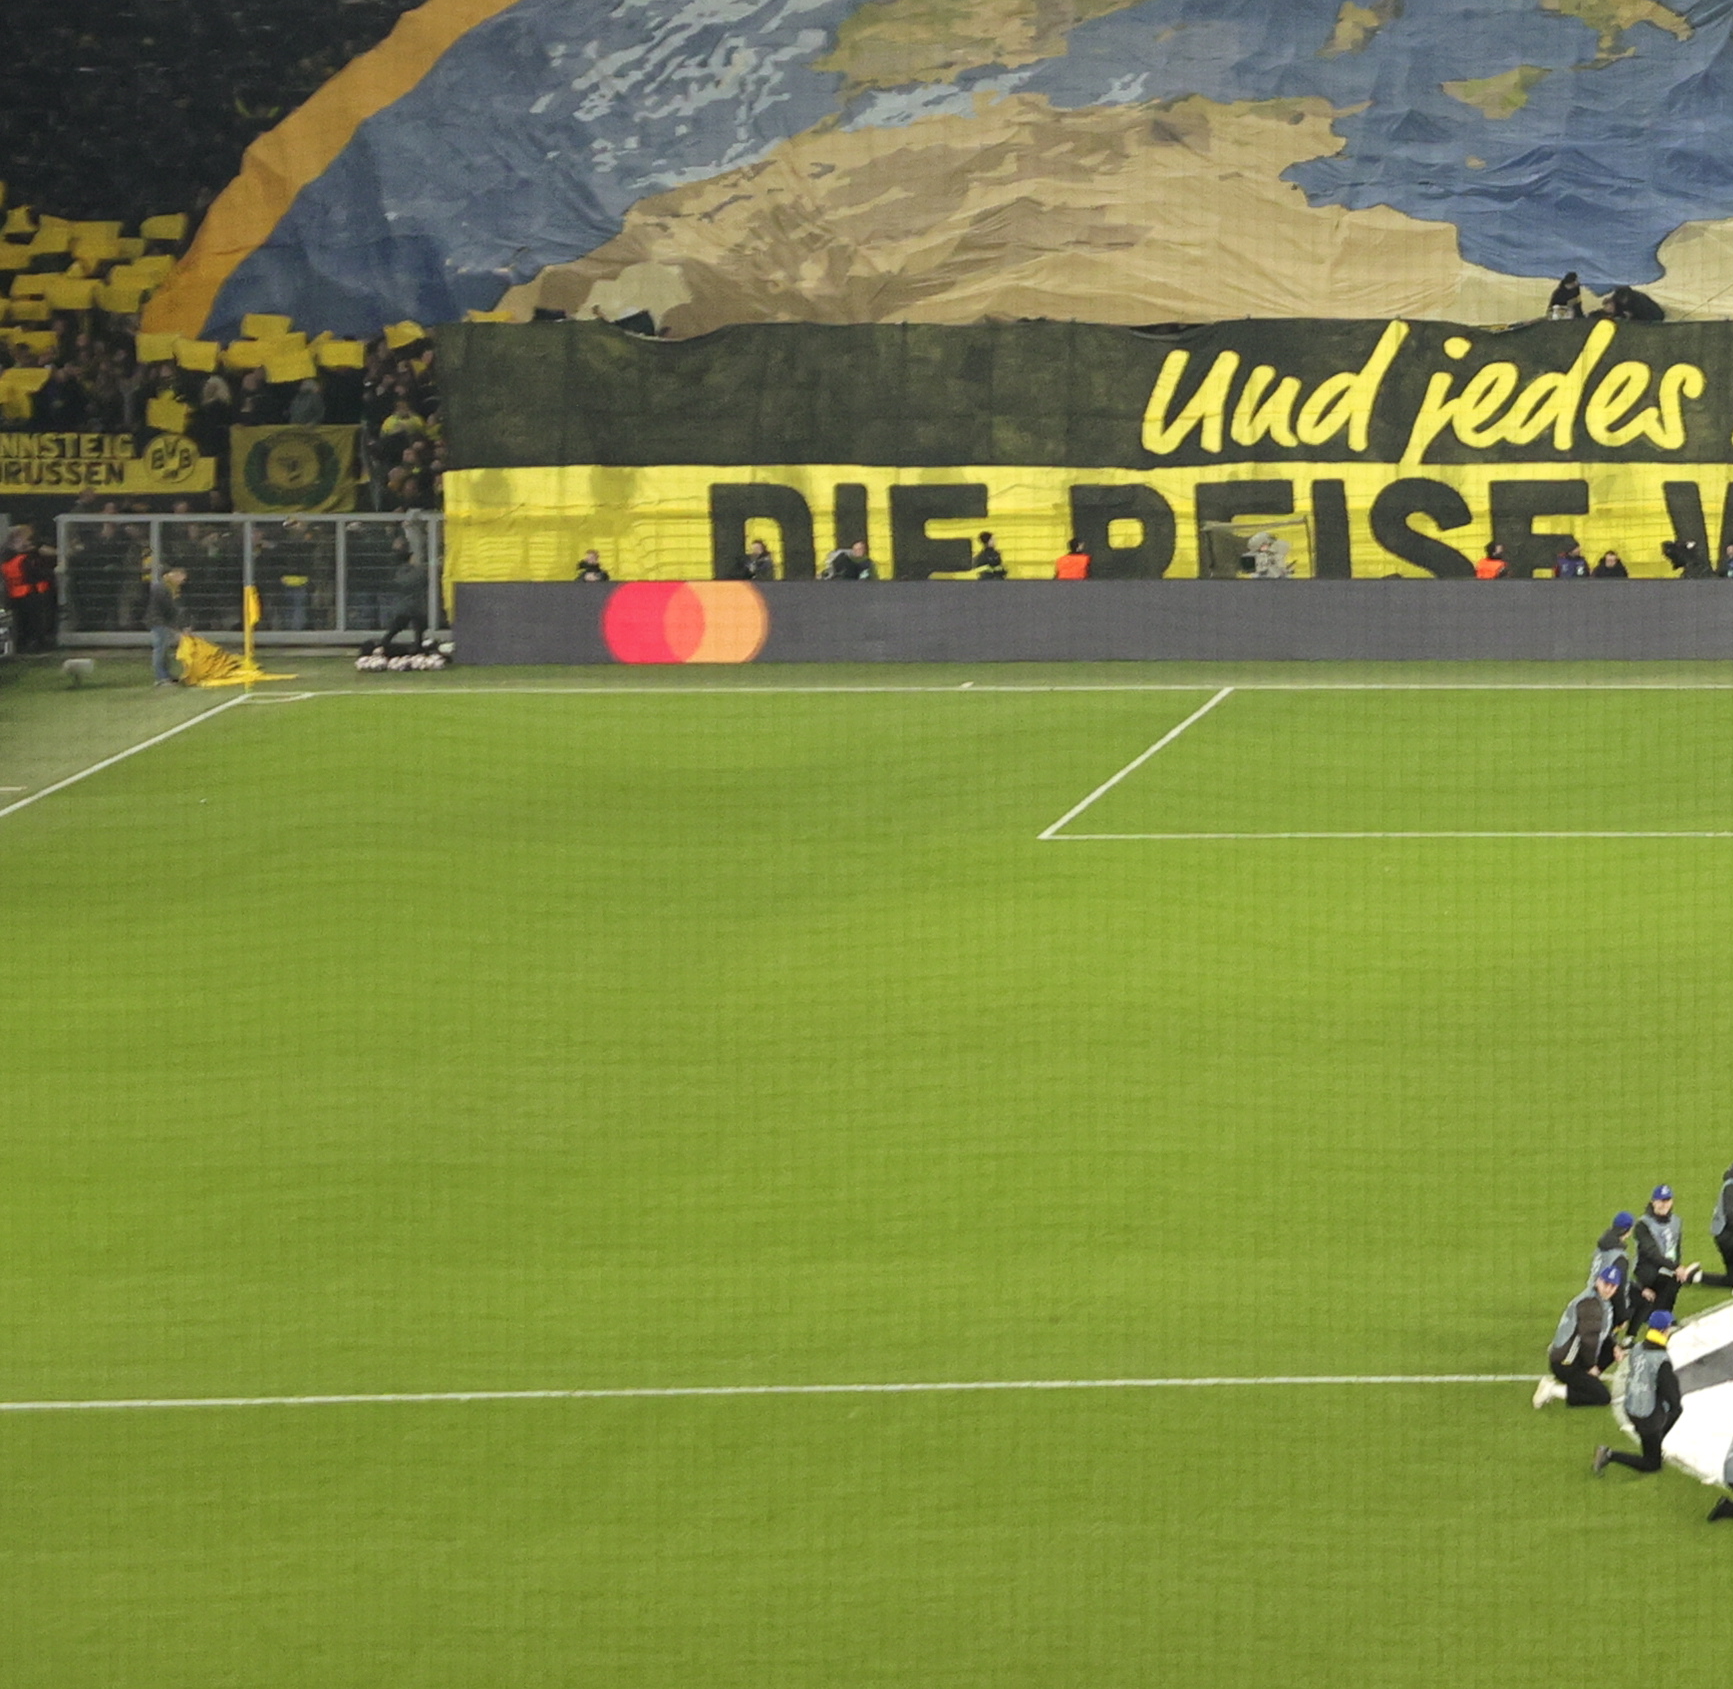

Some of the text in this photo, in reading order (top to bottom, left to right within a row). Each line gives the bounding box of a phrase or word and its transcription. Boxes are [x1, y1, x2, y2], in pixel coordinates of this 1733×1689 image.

[1142, 319, 1409, 455] Und
[1400, 319, 1705, 465] jedes
[0, 432, 136, 459] NNSTEIG
[0, 460, 125, 486] RUSSEN
[709, 482, 989, 580] DIE
[1071, 476, 1589, 579] REISE
